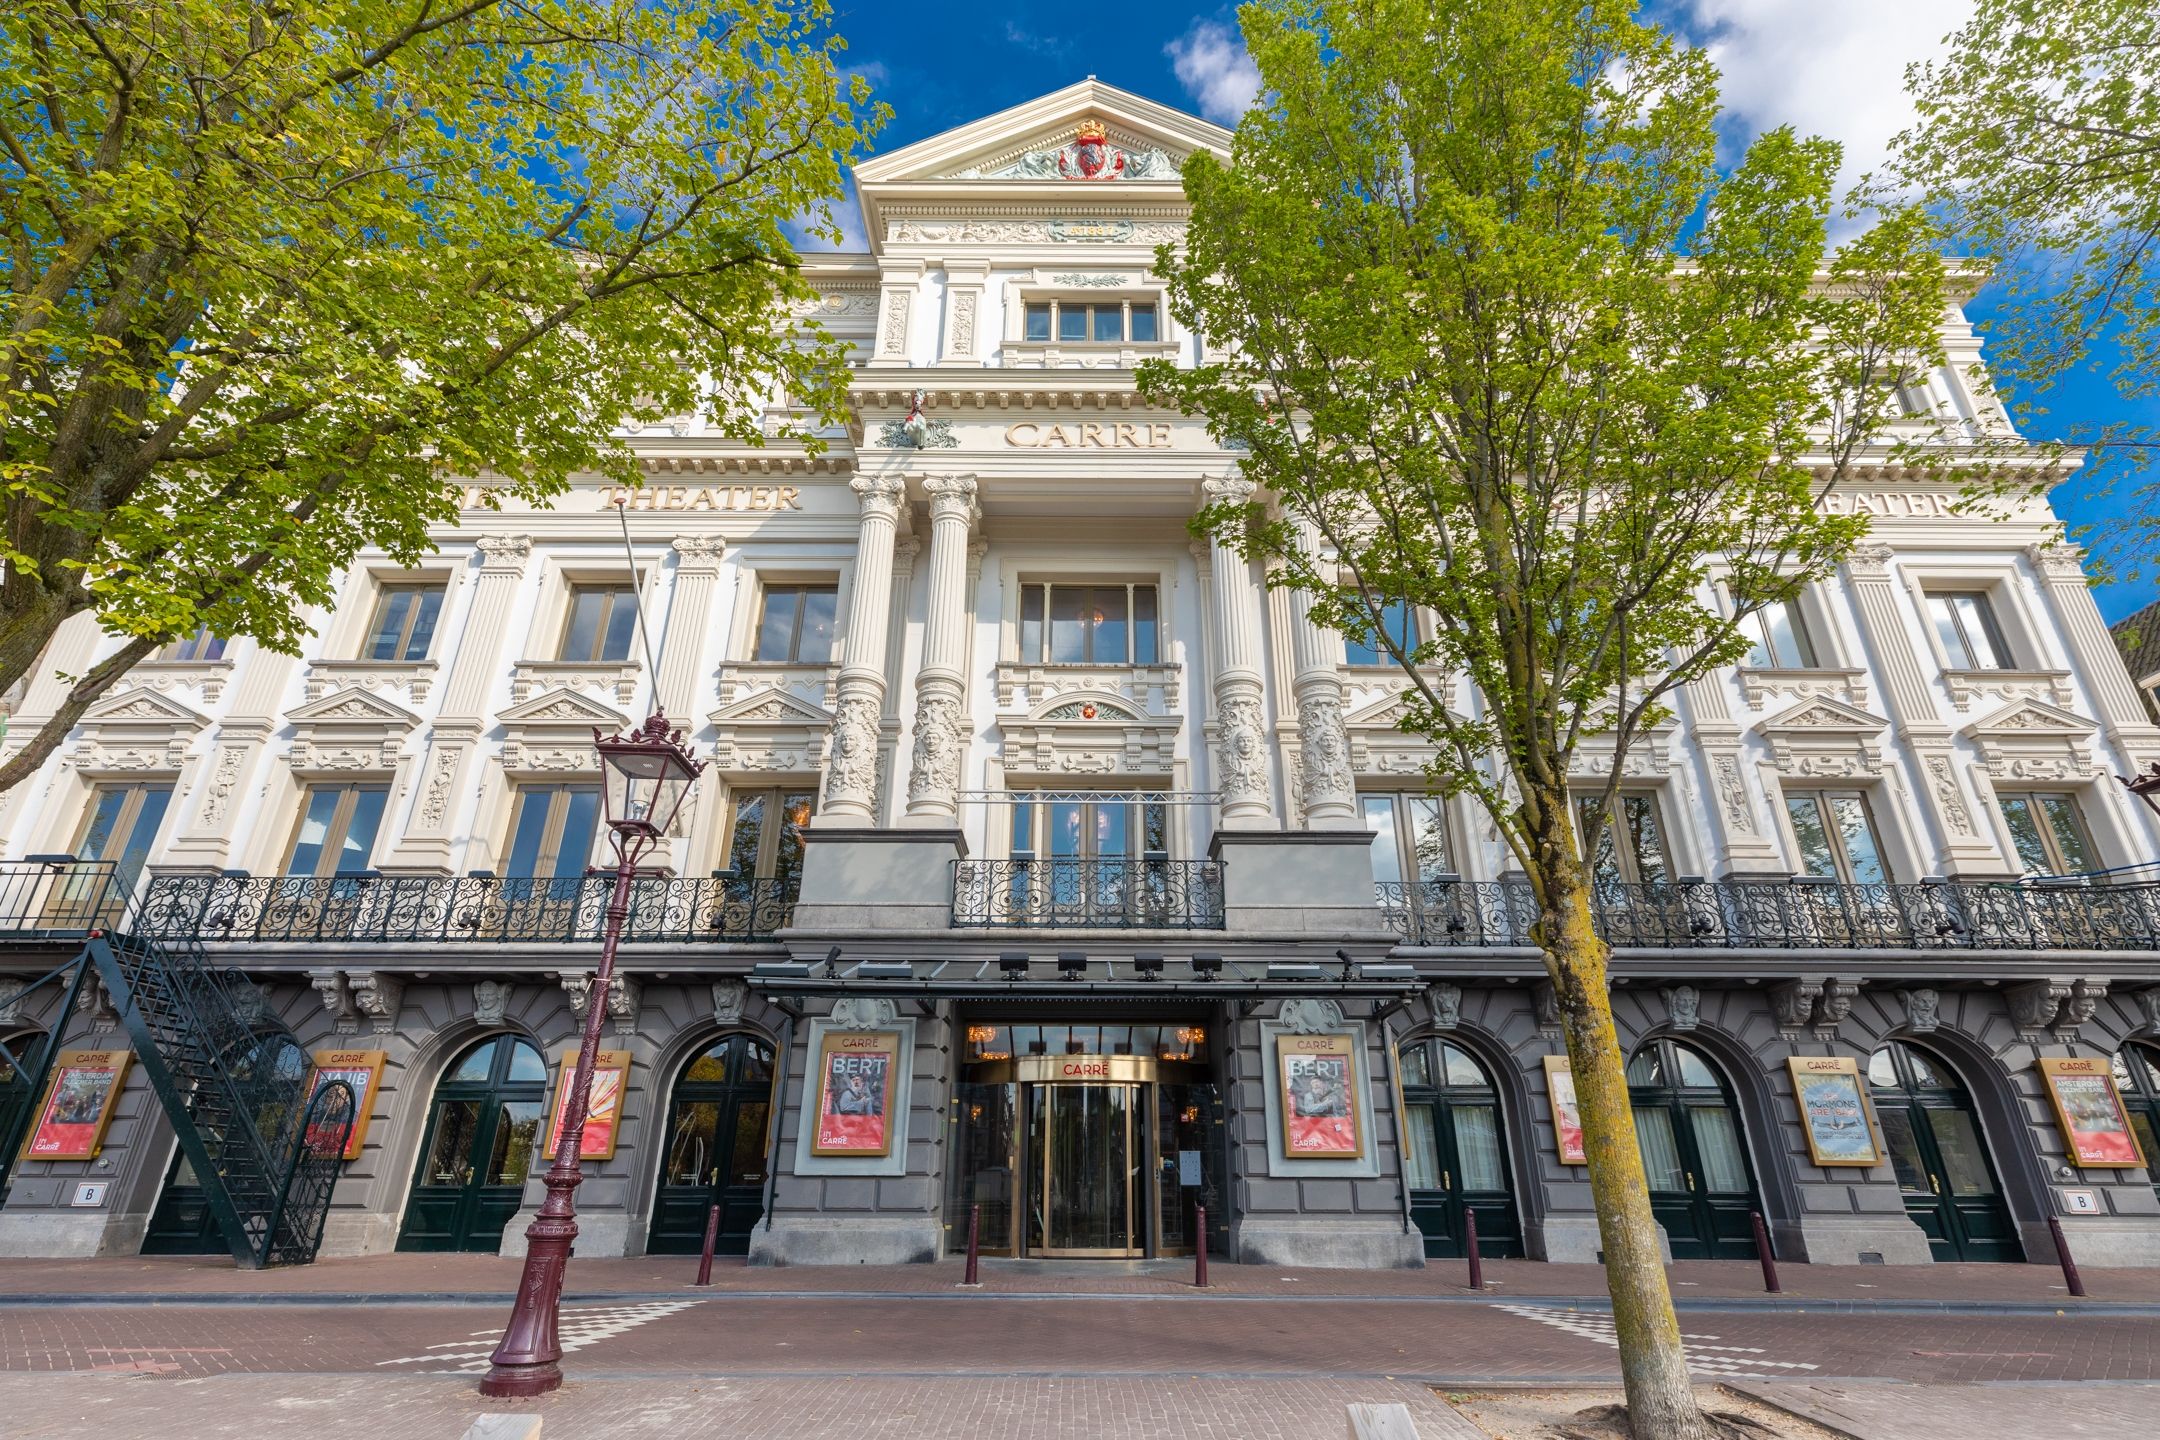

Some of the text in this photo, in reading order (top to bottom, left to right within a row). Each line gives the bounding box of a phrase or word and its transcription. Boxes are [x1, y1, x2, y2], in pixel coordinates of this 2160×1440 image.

[1004, 422, 1175, 449] CARRE
[598, 484, 804, 511] THEATER
[1790, 491, 1966, 519] EATER
[832, 1058, 886, 1074] BERT
[1290, 1060, 1341, 1077] BERT
[64, 1072, 115, 1080] AMSTERDAM
[2056, 1080, 2105, 1088] AMSTERDAM
[1807, 1100, 1857, 1108] MORMONS
[1810, 1108, 1830, 1116] ARE
[85, 1188, 94, 1201] B
[2077, 1196, 2087, 1208] B
